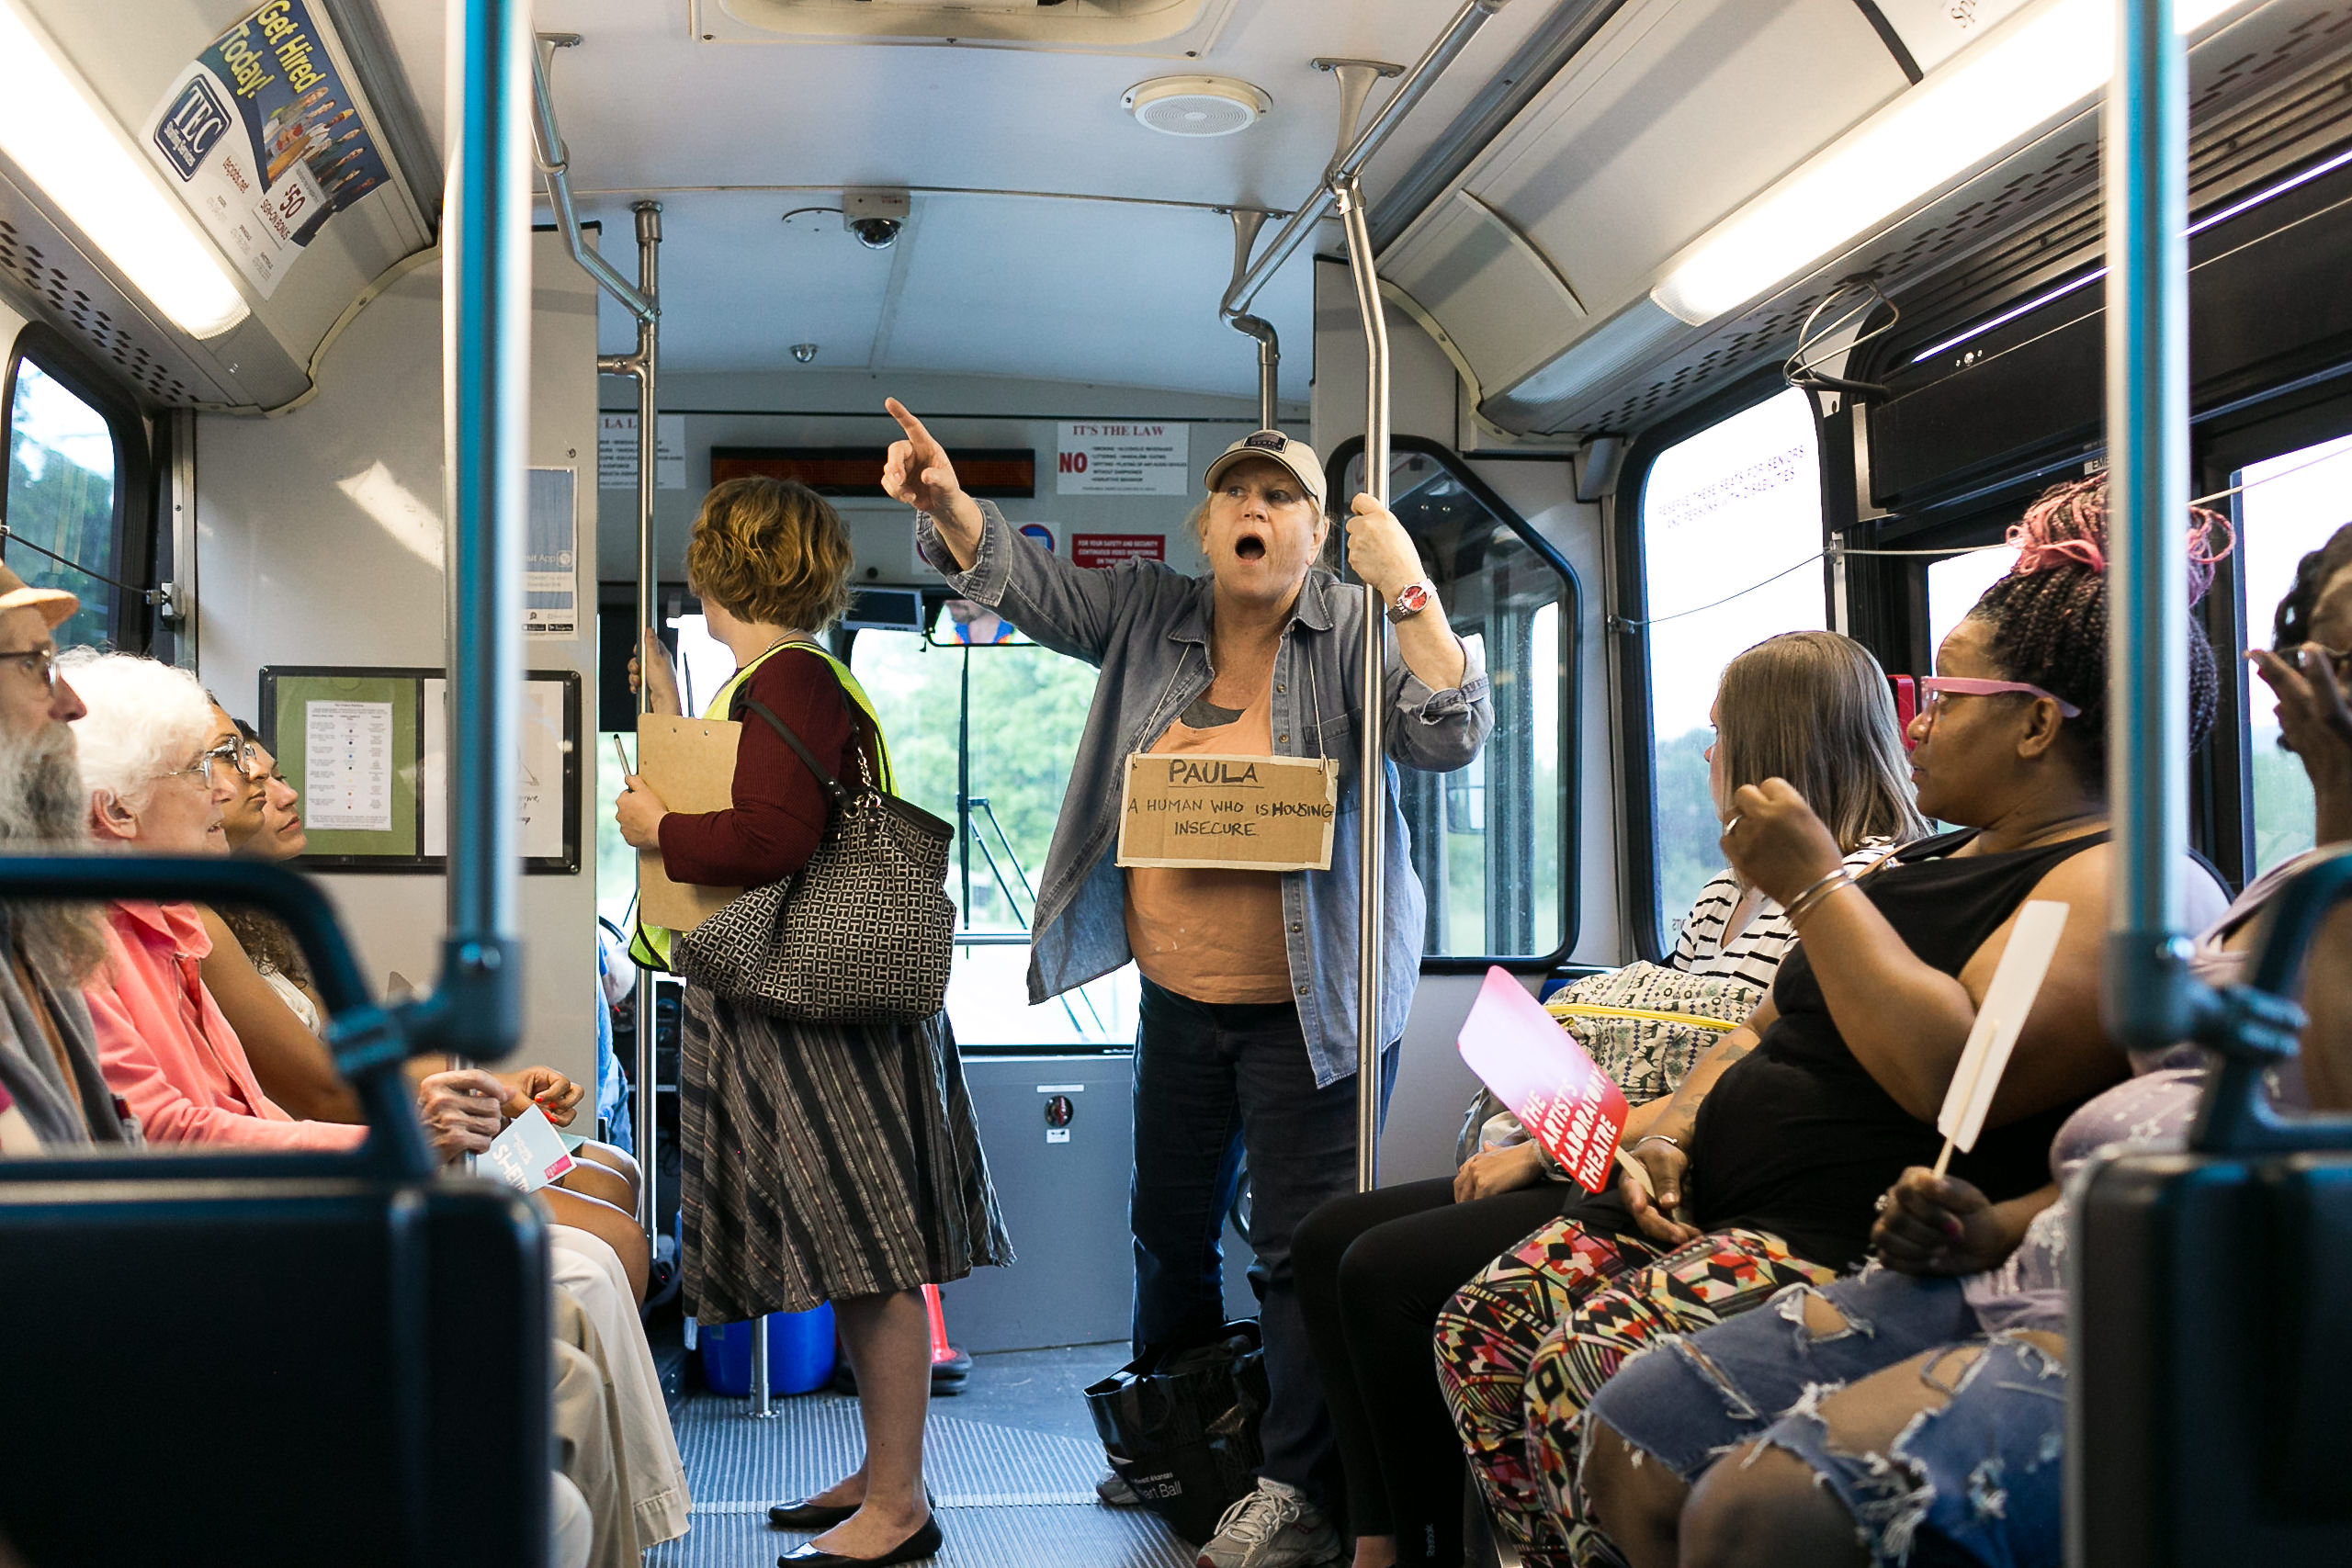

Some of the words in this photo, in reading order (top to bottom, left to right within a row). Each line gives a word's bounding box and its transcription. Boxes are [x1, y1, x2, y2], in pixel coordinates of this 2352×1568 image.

[257, 0, 299, 45] Get
[219, 23, 276, 99] Today!
[276, 34, 327, 94] Hired
[173, 85, 223, 153] TEC
[222, 155, 250, 194] tecjobs.net
[260, 198, 277, 227] SIGN-ON
[275, 218, 290, 241] BONUS
[280, 183, 306, 219] $50
[1073, 425, 1098, 436] IT'S
[1102, 425, 1129, 436] THE
[1133, 425, 1165, 436] LAW
[1058, 452, 1088, 473] NO
[1169, 759, 1258, 784] PAULA
[1127, 798, 1137, 814] A
[1148, 798, 1203, 812] HUMAN
[1211, 800, 1243, 813] WHO
[1256, 802, 1269, 814] IS
[1272, 803, 1333, 818] HOUSING
[1175, 820, 1257, 836] INSECURE
[1520, 1089, 1547, 1129] THE
[1540, 1077, 1580, 1152] ARTIST'S
[1559, 1064, 1608, 1171] LABORATORY
[1578, 1113, 1618, 1190] THEATRE
[1159, 1480, 1183, 1498] Ball
